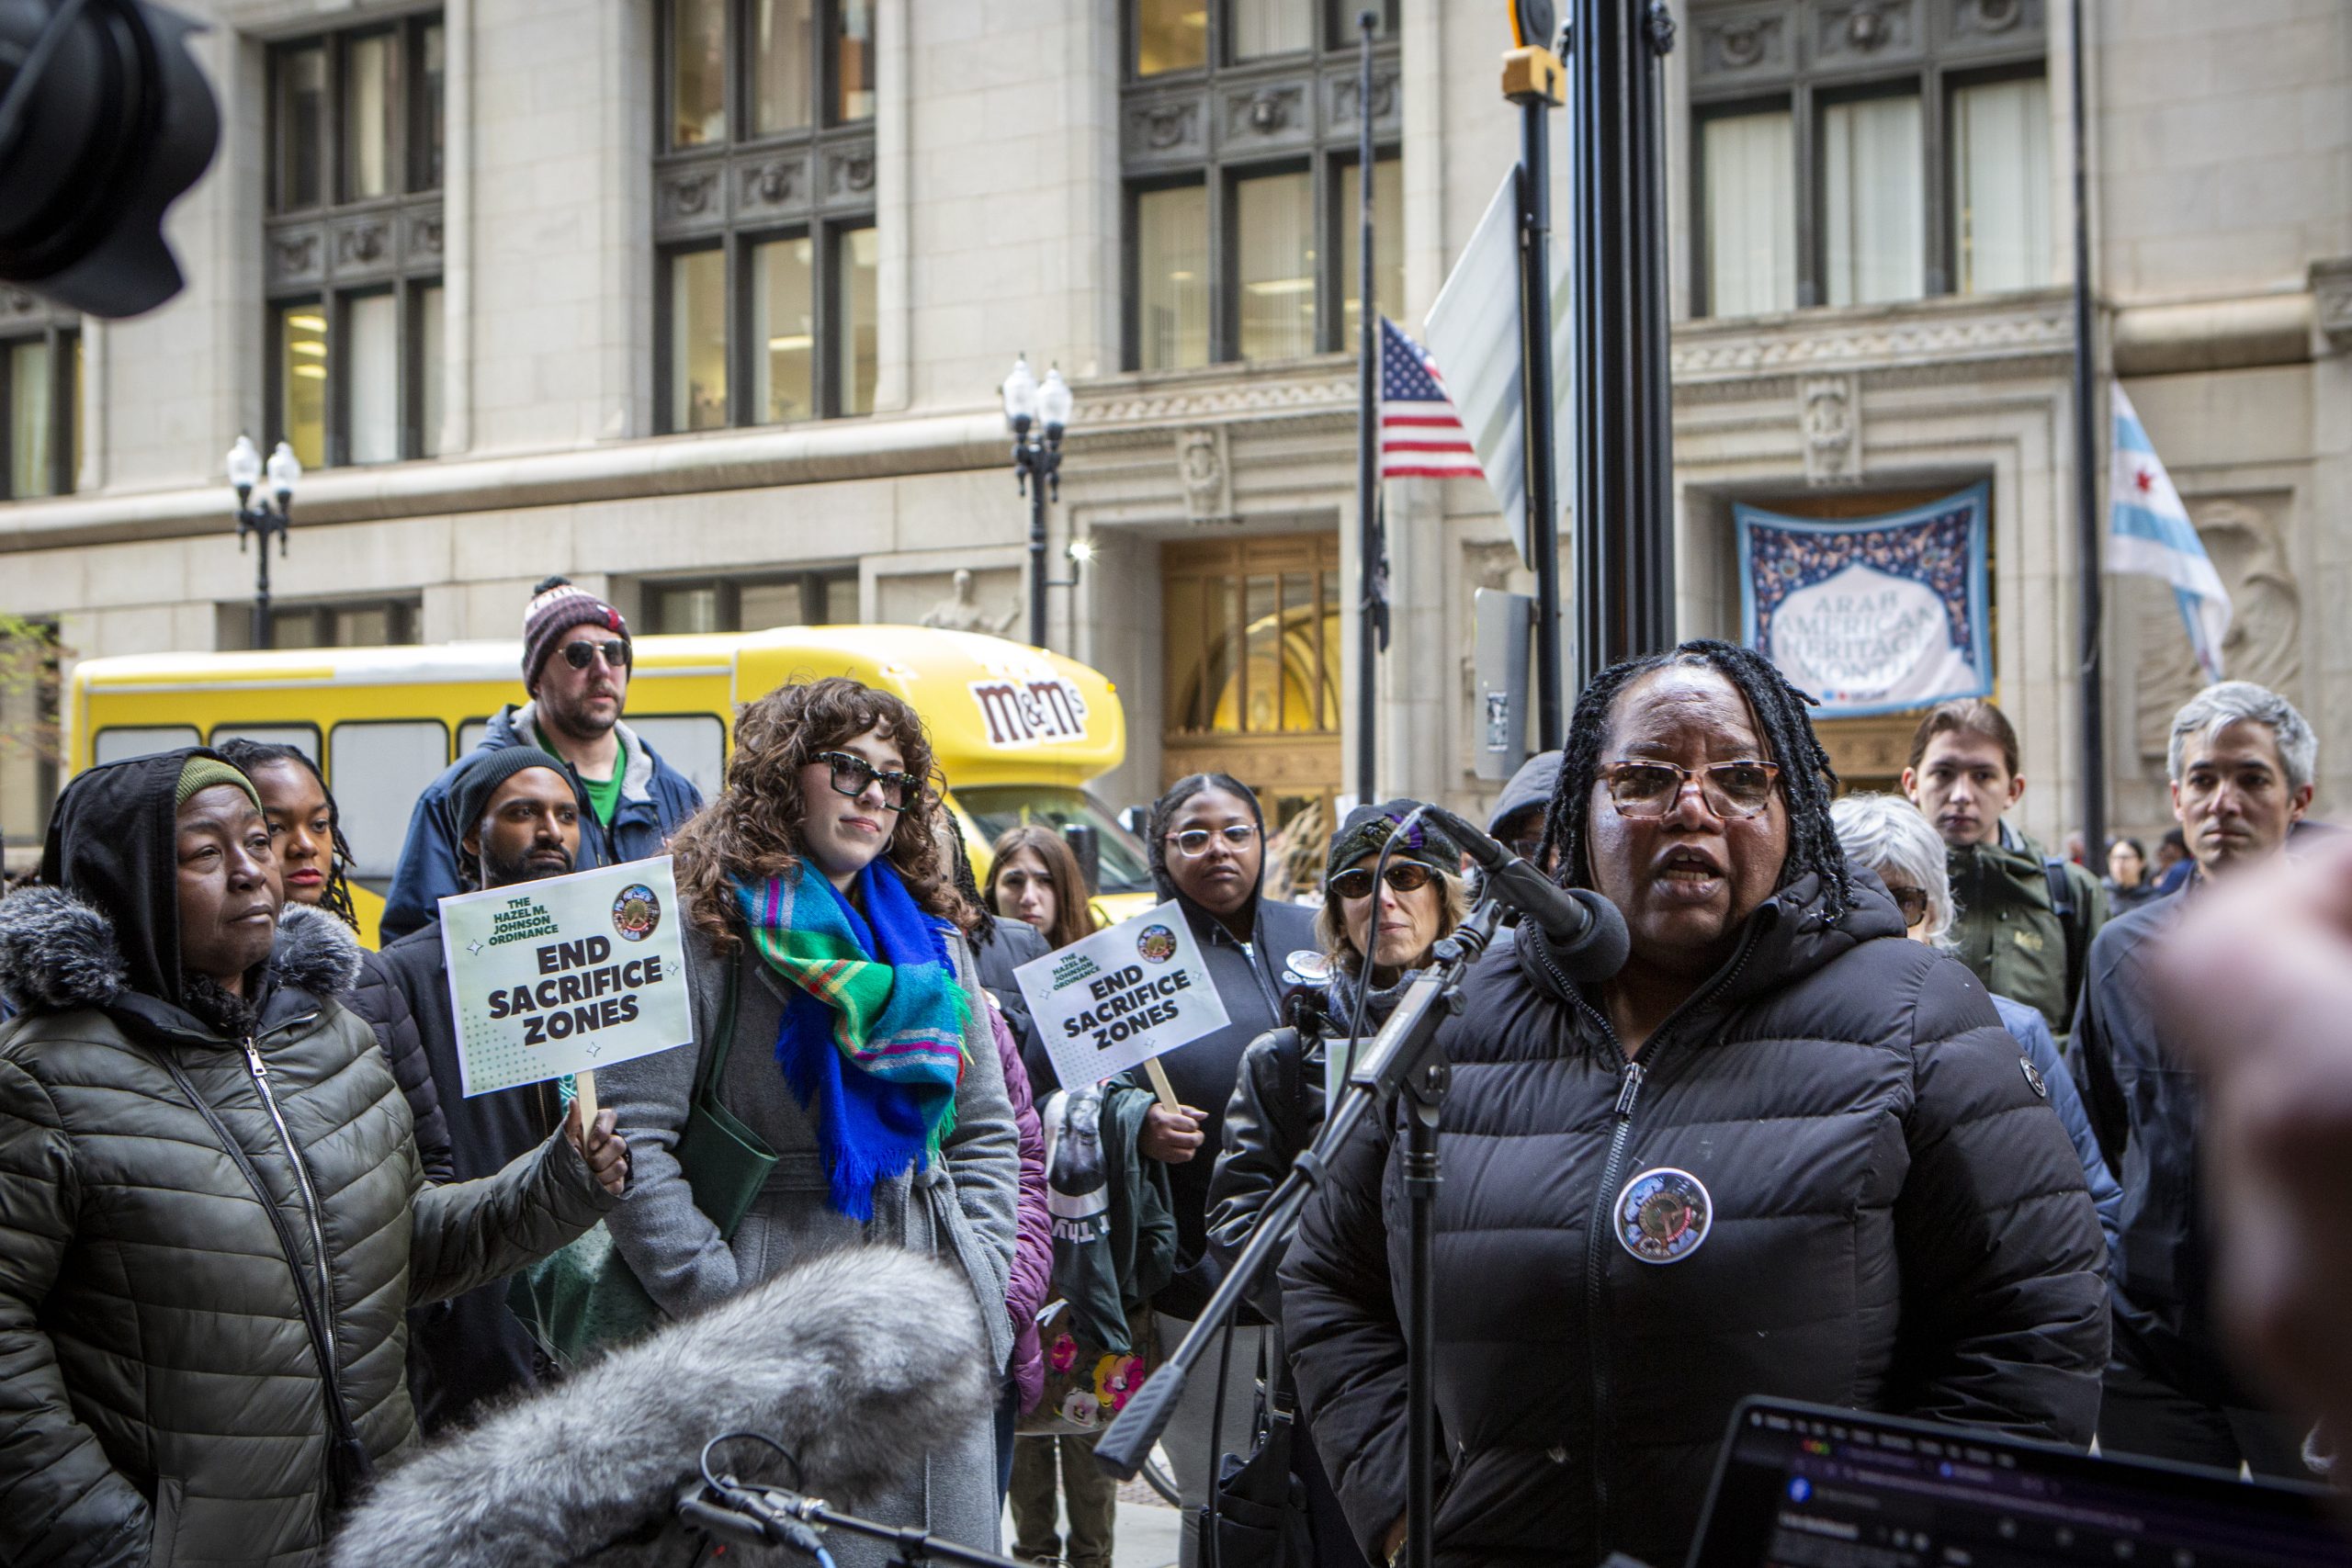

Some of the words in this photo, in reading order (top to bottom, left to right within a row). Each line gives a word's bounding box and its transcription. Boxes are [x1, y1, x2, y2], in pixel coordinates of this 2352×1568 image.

[493, 908, 531, 924] HAZEL
[532, 905, 548, 916] M.
[507, 897, 531, 909] THE
[489, 924, 560, 946] ORDINANCE
[493, 915, 550, 935] JOHNSON
[537, 935, 611, 976] END
[1059, 953, 1077, 964] THE
[1052, 961, 1079, 976] HAZEL
[1053, 964, 1101, 991] ORDINANCE
[1055, 960, 1093, 983] JOHNSON
[488, 955, 663, 1020] SACRIFICE
[1089, 964, 1143, 1001] END
[1063, 968, 1192, 1038] SACRIFICE
[523, 994, 639, 1046] ZONES
[1091, 998, 1180, 1051] ZONES
